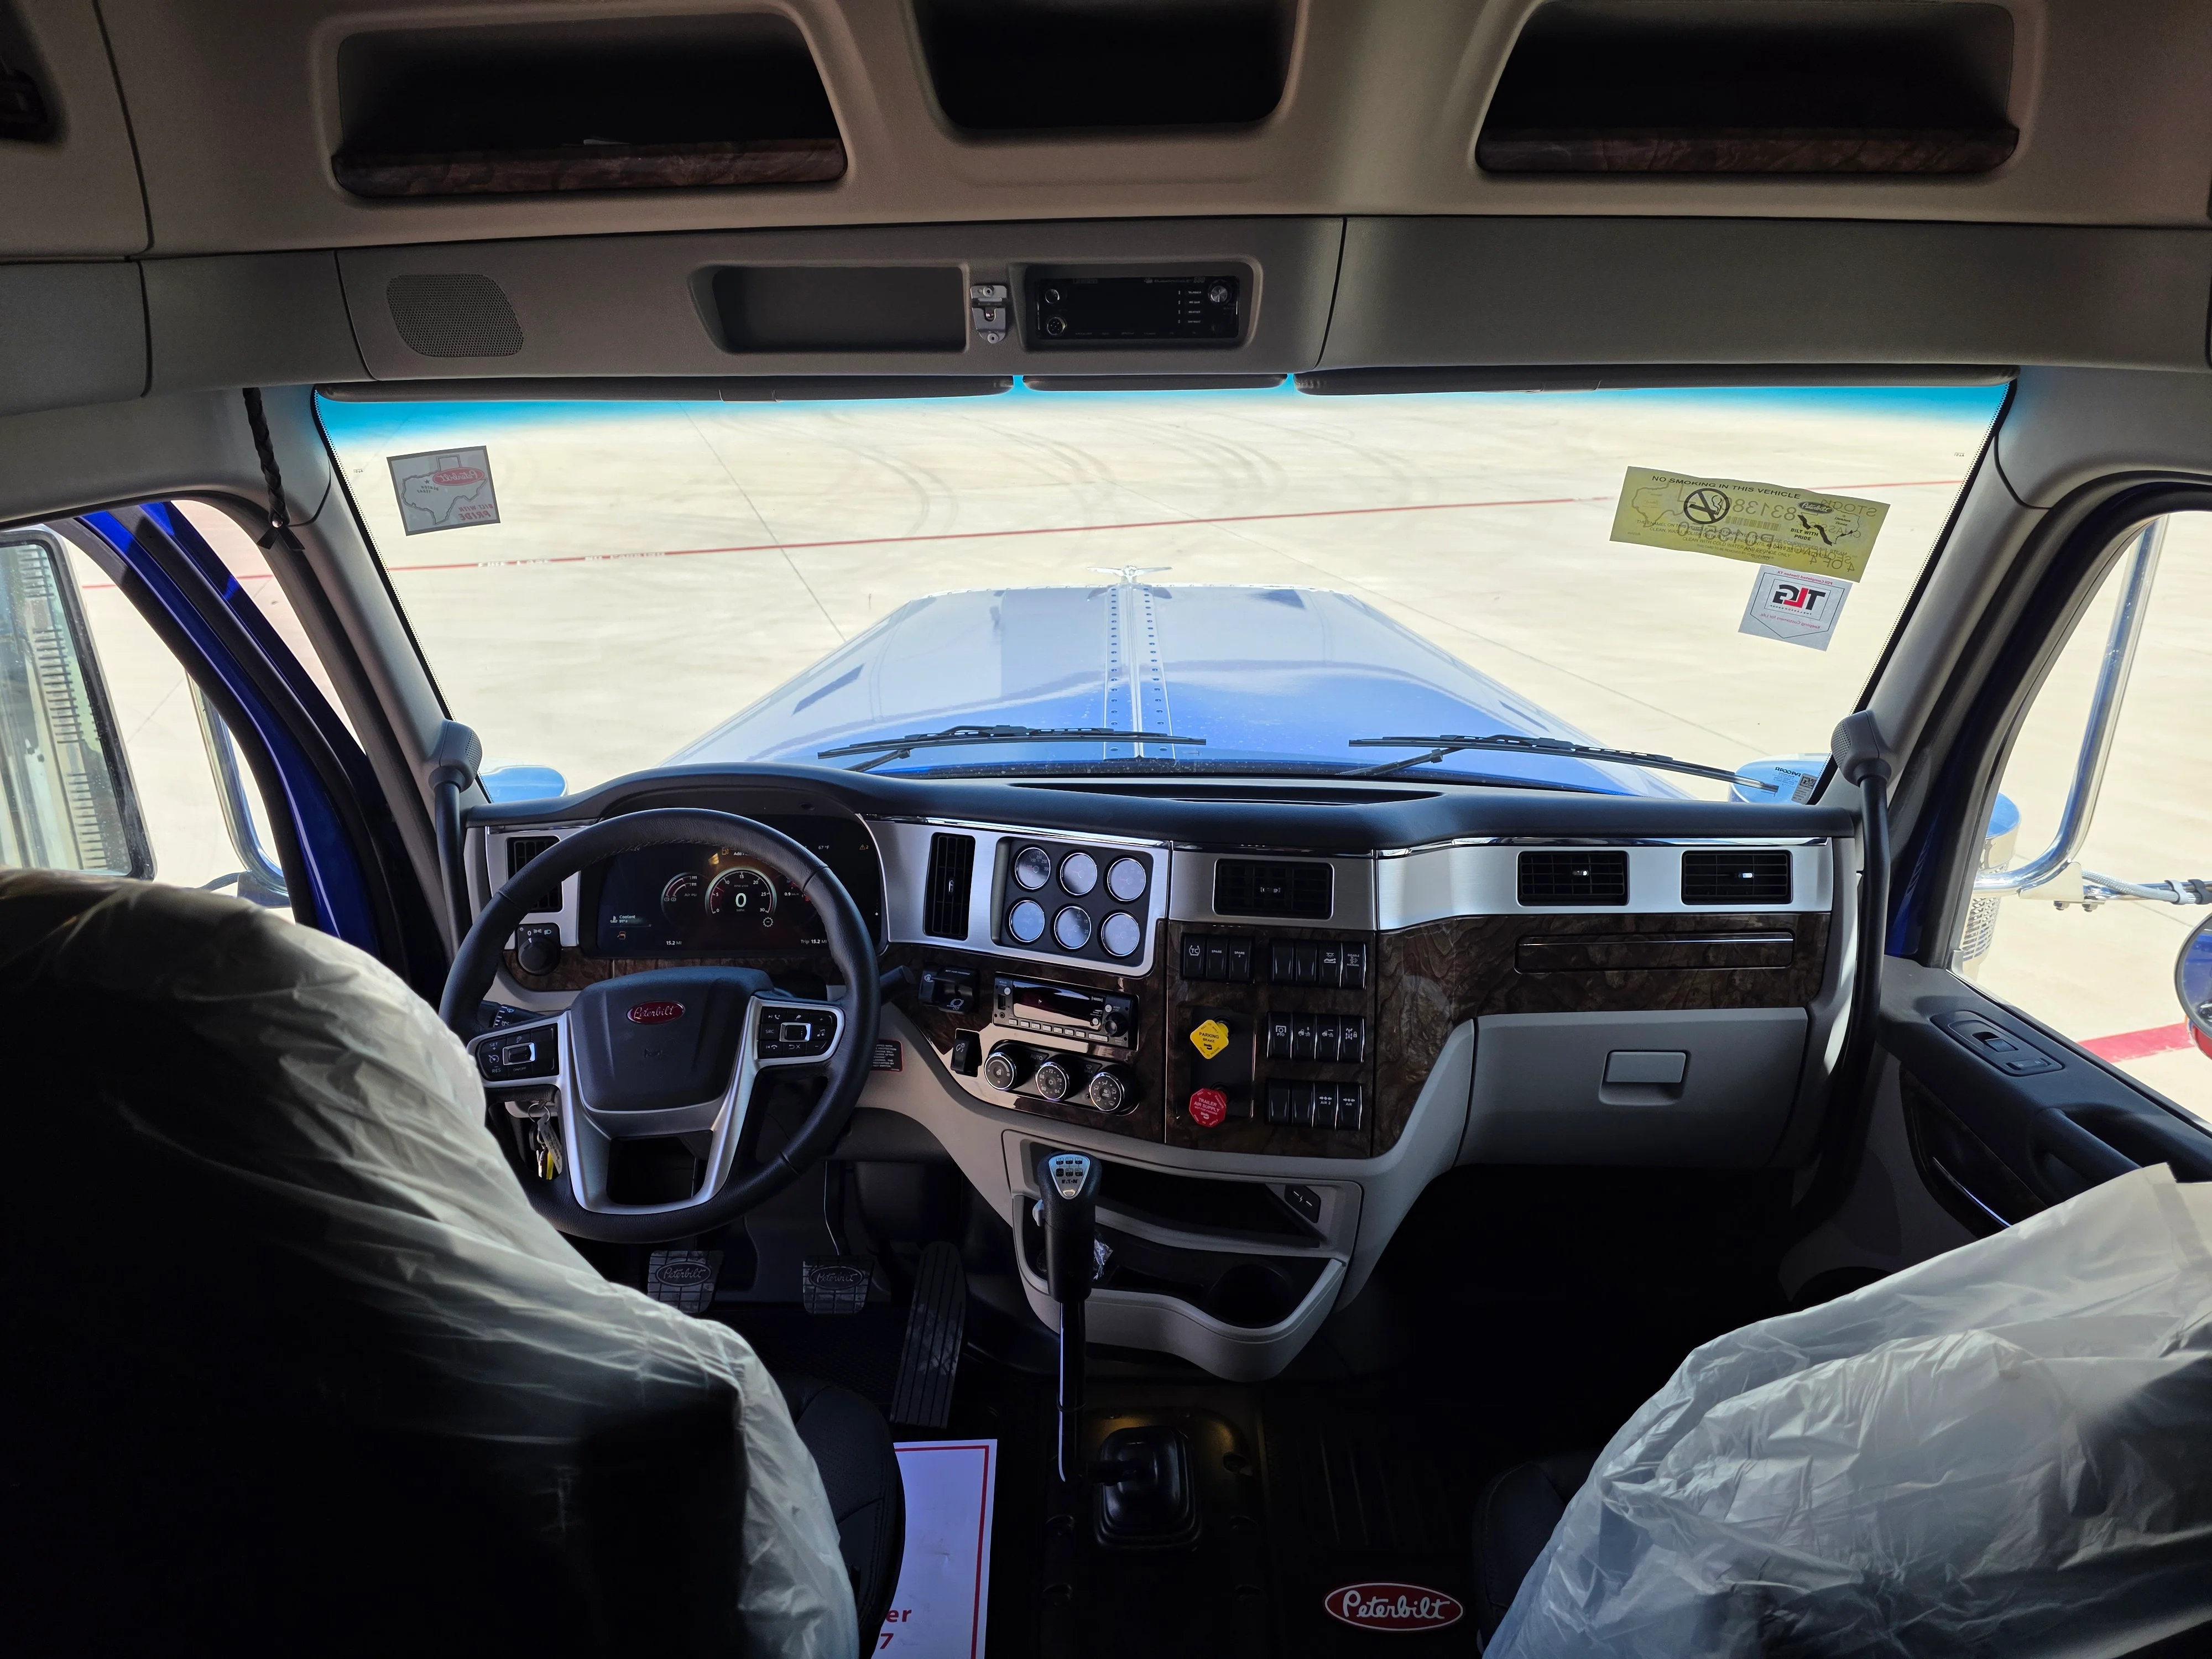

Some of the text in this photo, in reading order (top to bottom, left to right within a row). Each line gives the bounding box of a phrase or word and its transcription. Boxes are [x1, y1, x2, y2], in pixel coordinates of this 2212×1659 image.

[1669, 478, 1716, 487] SMOKING
[1758, 488, 1801, 499] VEHICLE
[1802, 503, 1830, 513] Peterbilt
[735, 893, 747, 907] 0
[634, 1005, 676, 1020] Peterbilt
[1199, 1098, 1217, 1107] TRAILER
[1202, 1104, 1219, 1112] SUPPLY
[664, 1267, 706, 1281] Peterbilt
[1343, 1590, 1450, 1619] Peterbilt
